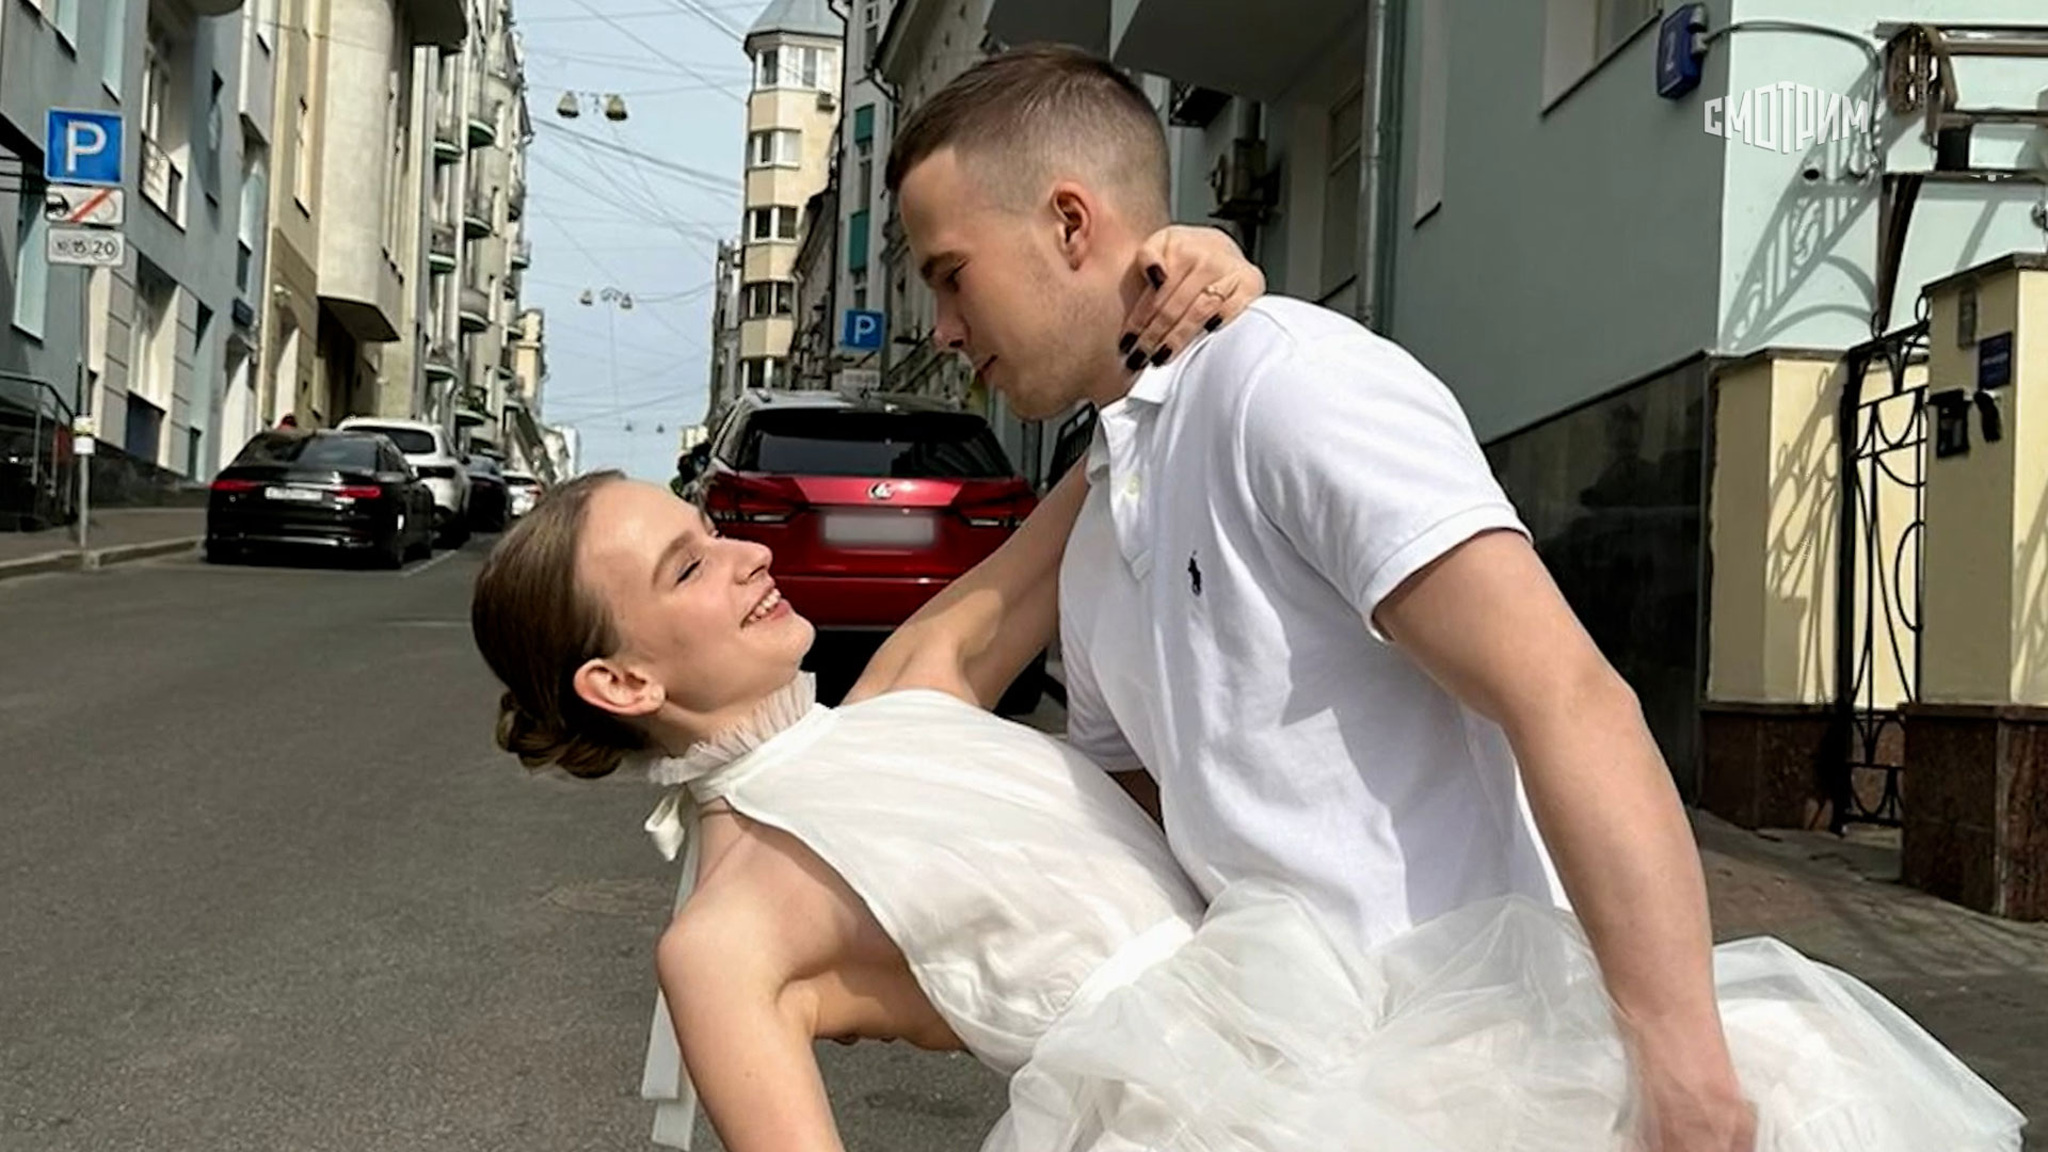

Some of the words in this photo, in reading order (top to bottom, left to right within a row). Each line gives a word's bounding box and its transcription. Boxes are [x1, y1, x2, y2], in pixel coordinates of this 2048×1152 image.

[67, 120, 107, 172] P
[93, 241, 115, 256] 20
[854, 314, 876, 345] P
